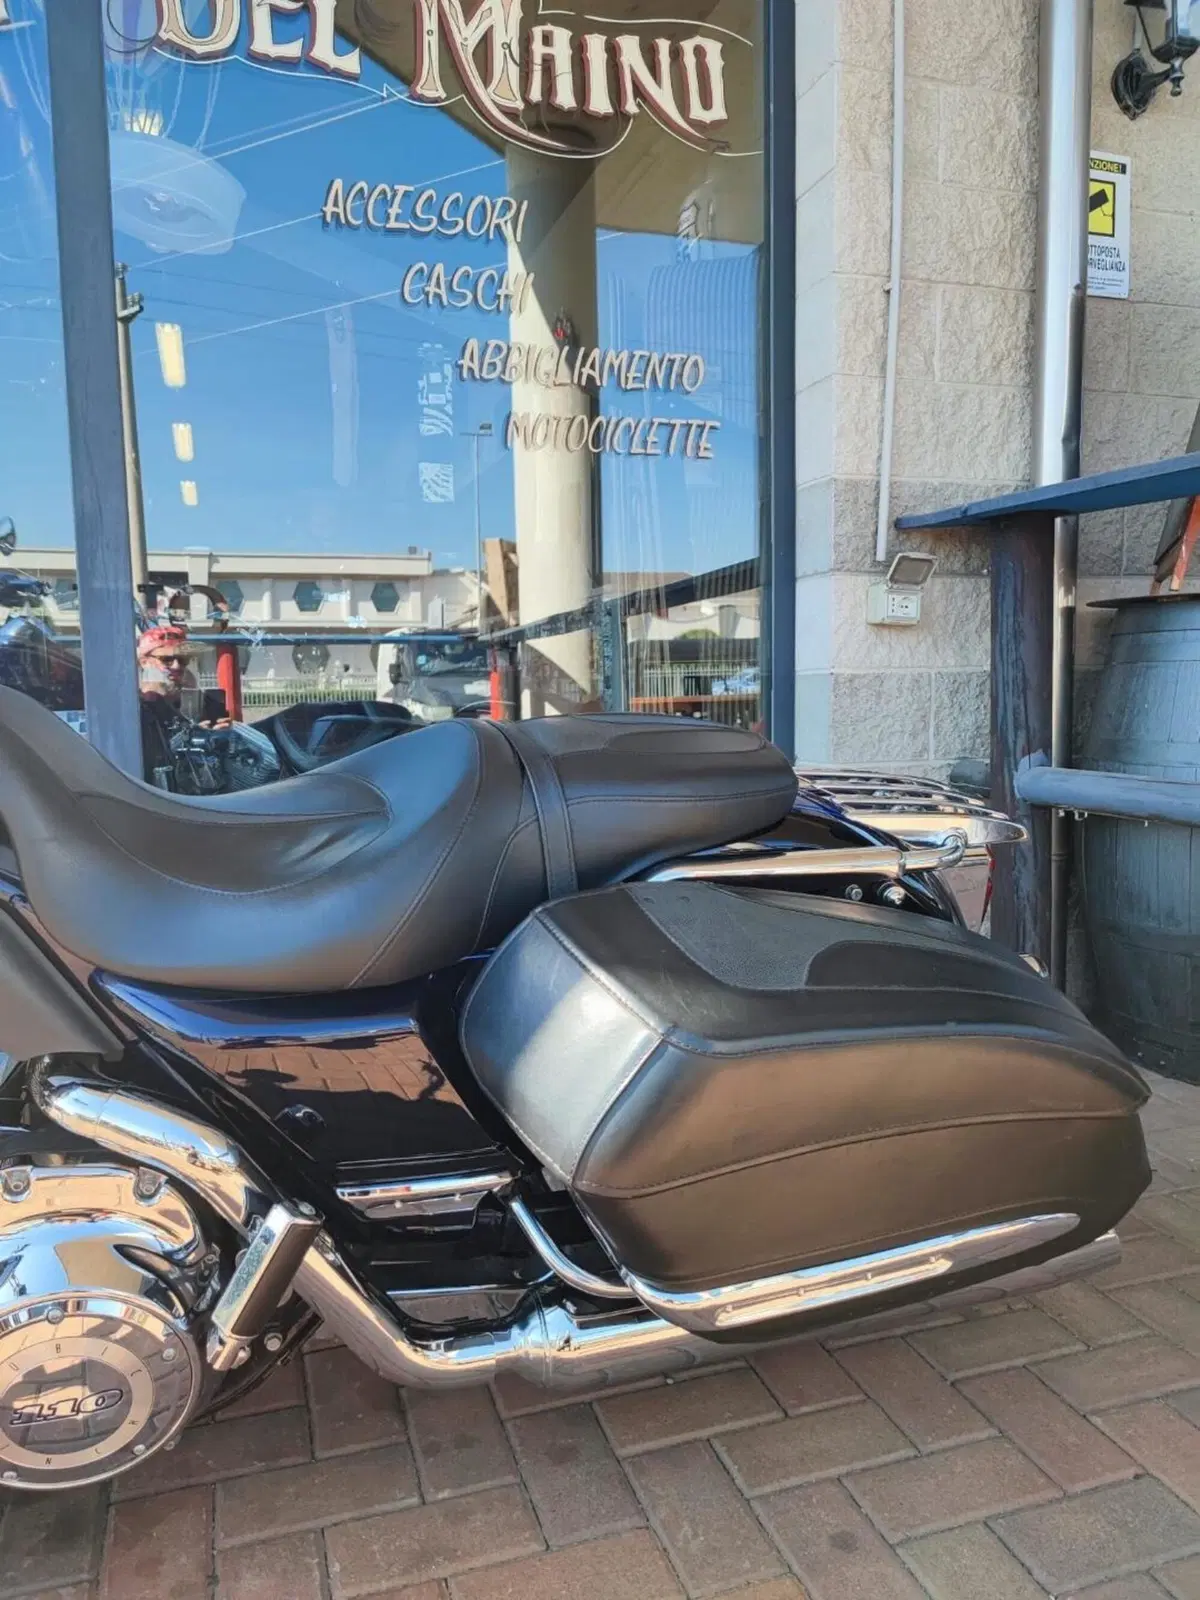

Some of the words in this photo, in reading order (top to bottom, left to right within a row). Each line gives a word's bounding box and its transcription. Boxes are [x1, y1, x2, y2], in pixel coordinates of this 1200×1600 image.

[411, 0, 729, 150] MAINO
[322, 177, 529, 244] ACCESSORI
[402, 261, 535, 314] CASCHI
[458, 337, 705, 394] ABBIGLIAMENTO
[505, 411, 720, 459] MOTOCICLETTE
[9, 1388, 124, 1427] 110
